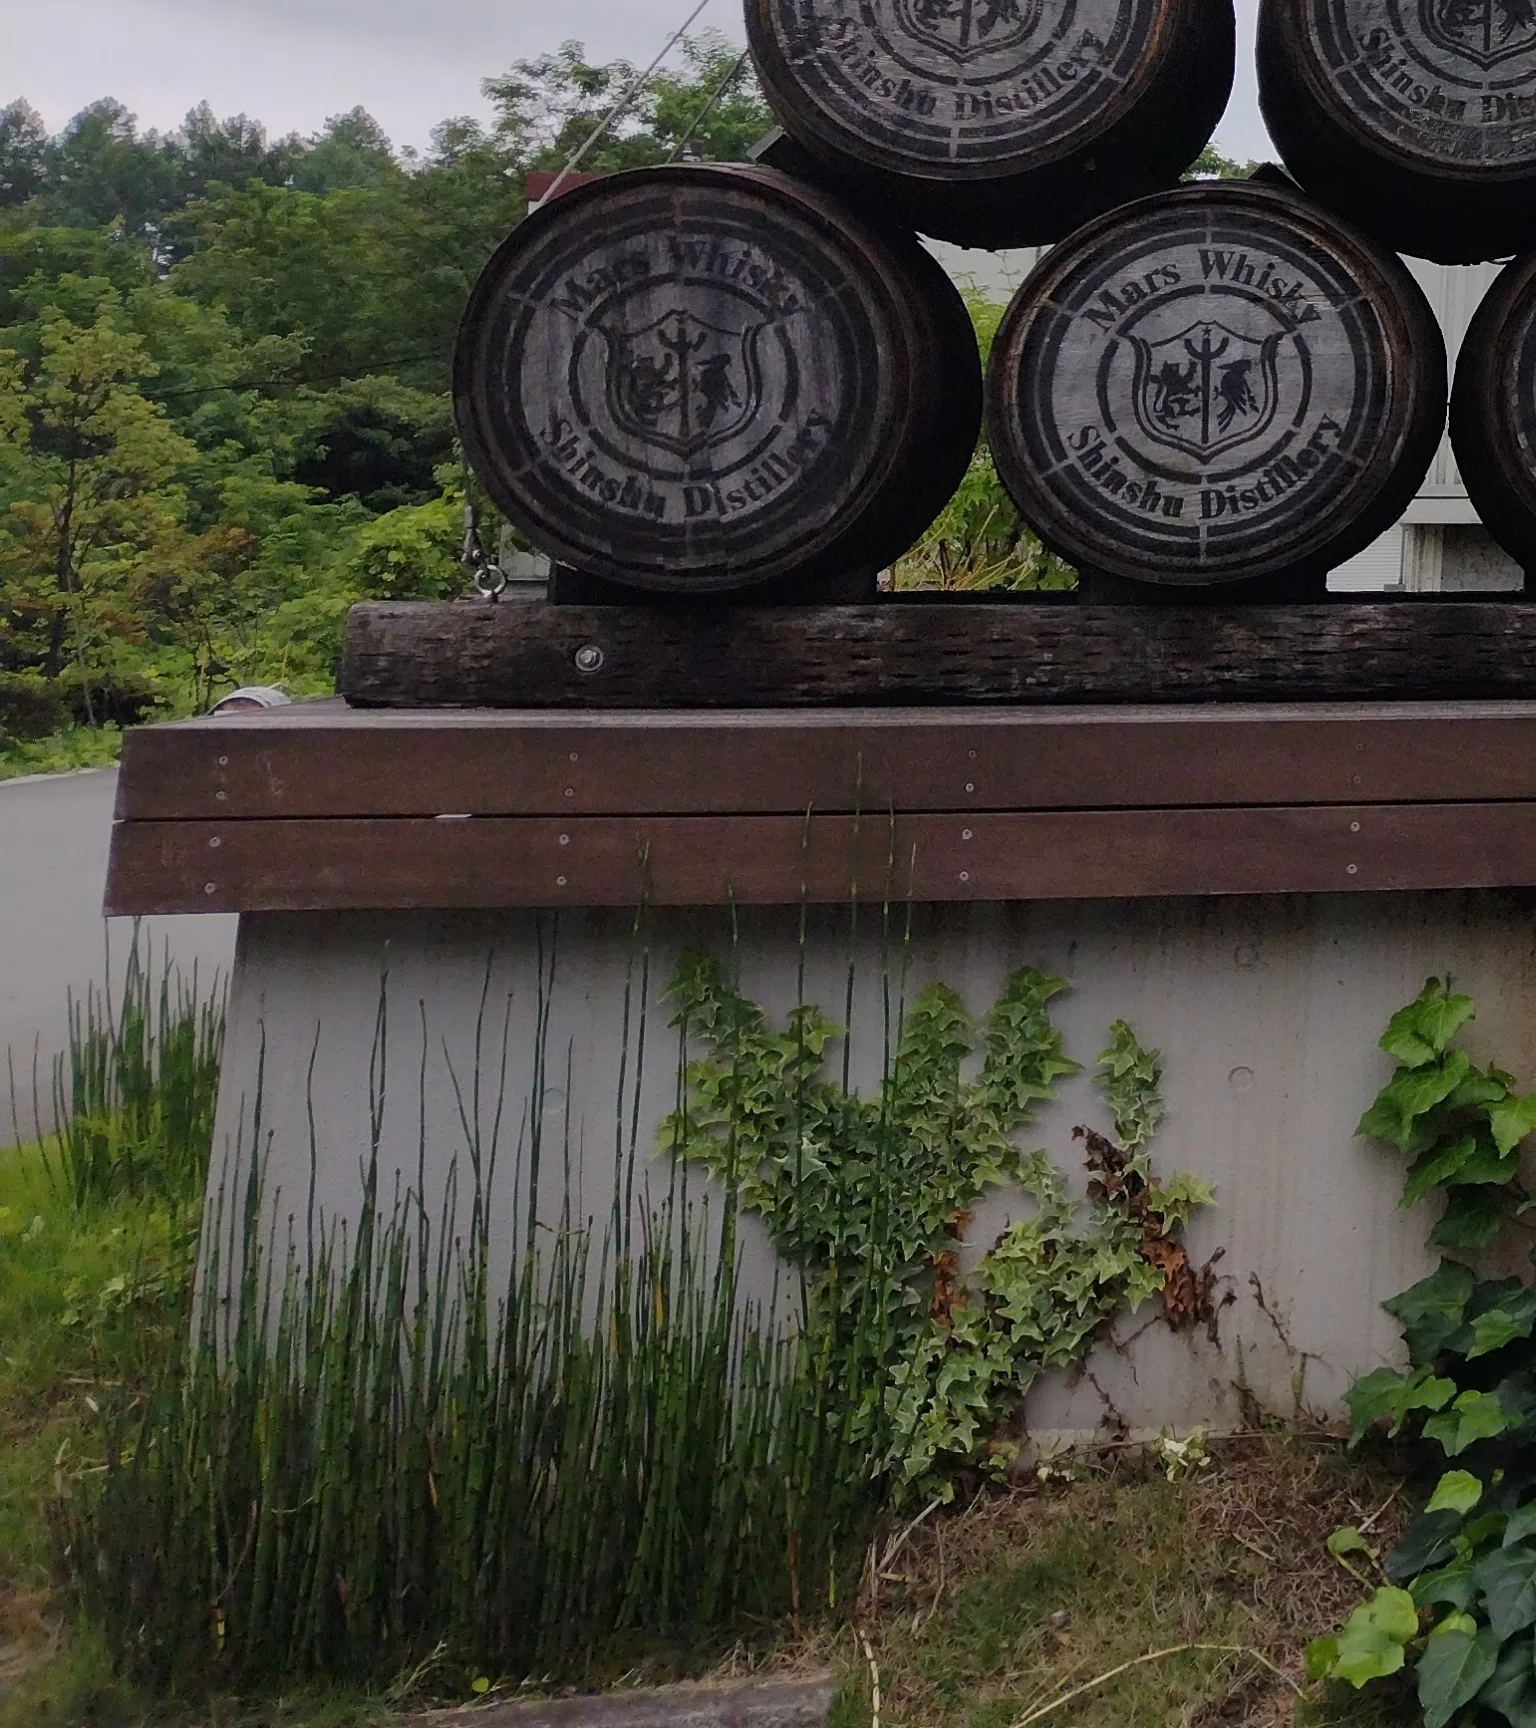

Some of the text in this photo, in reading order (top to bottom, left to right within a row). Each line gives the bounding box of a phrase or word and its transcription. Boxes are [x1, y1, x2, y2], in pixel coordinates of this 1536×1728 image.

[1360, 27, 1466, 120] Shinshu
[1082, 249, 1322, 332] Mars Whisky
[541, 408, 833, 518] Shinshu Distillery
[1068, 414, 1344, 519] Shinshu Distillery
